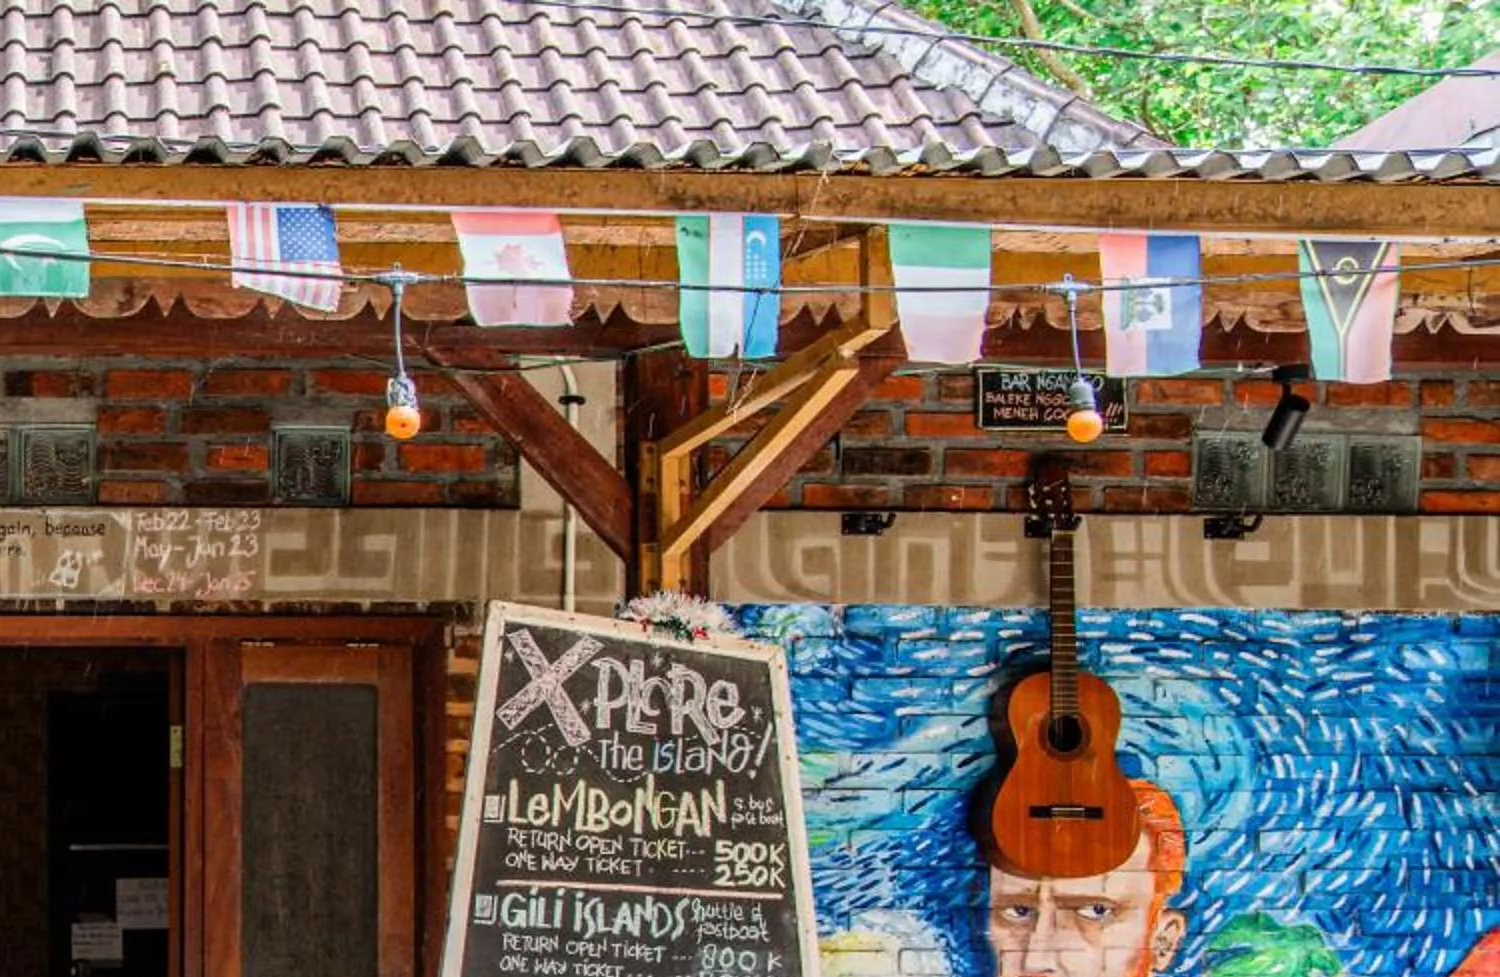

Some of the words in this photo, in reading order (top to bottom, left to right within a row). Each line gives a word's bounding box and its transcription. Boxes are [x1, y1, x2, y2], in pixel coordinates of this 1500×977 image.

[1000, 374, 1031, 391] BAR
[45, 516, 106, 537] because
[599, 730, 644, 771] The
[507, 827, 571, 852] RETURN
[575, 834, 623, 852] OPEN
[714, 840, 786, 864] 500K
[505, 850, 537, 871] ONE
[541, 854, 578, 872] WAY
[714, 863, 787, 889] 250K
[502, 932, 559, 952] RETURN
[565, 937, 607, 957] OPEN
[500, 954, 529, 973] ONE
[534, 956, 567, 975] WAY
